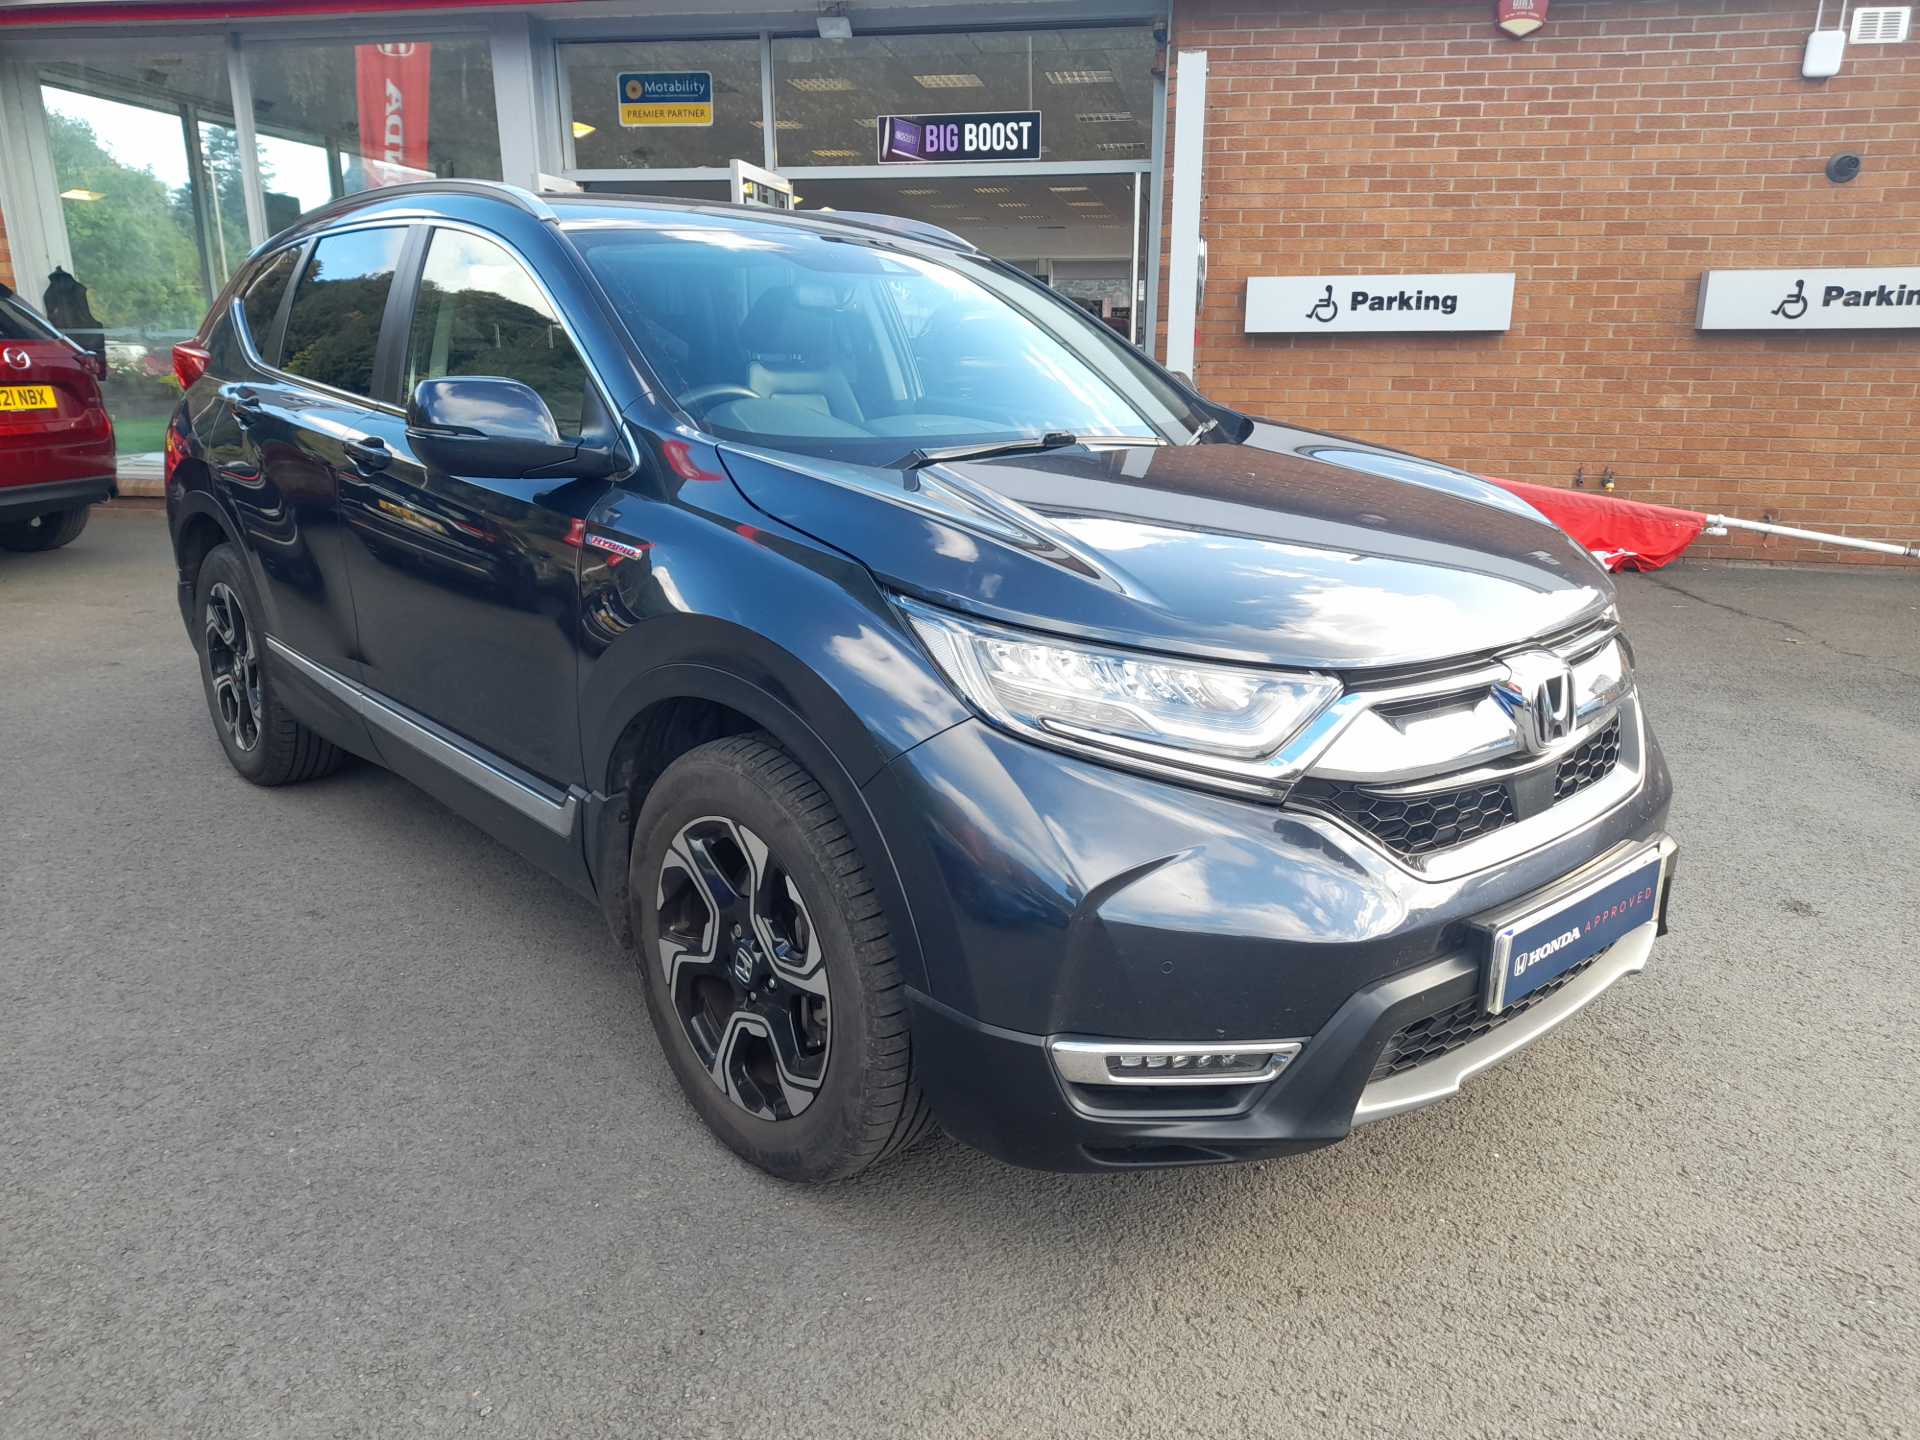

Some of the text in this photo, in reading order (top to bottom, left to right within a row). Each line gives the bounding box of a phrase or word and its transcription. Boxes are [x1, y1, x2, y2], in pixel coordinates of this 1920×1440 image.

[644, 80, 705, 95] Motability
[628, 109, 705, 119] PREMIER PARTNER
[925, 124, 959, 153] BIG
[964, 121, 1032, 152] BOOST
[1350, 290, 1458, 315] Parking
[0, 389, 47, 406] 21 NBX
[592, 535, 636, 555] HYBRID
[1527, 887, 1652, 966] HONDA APPROVED
